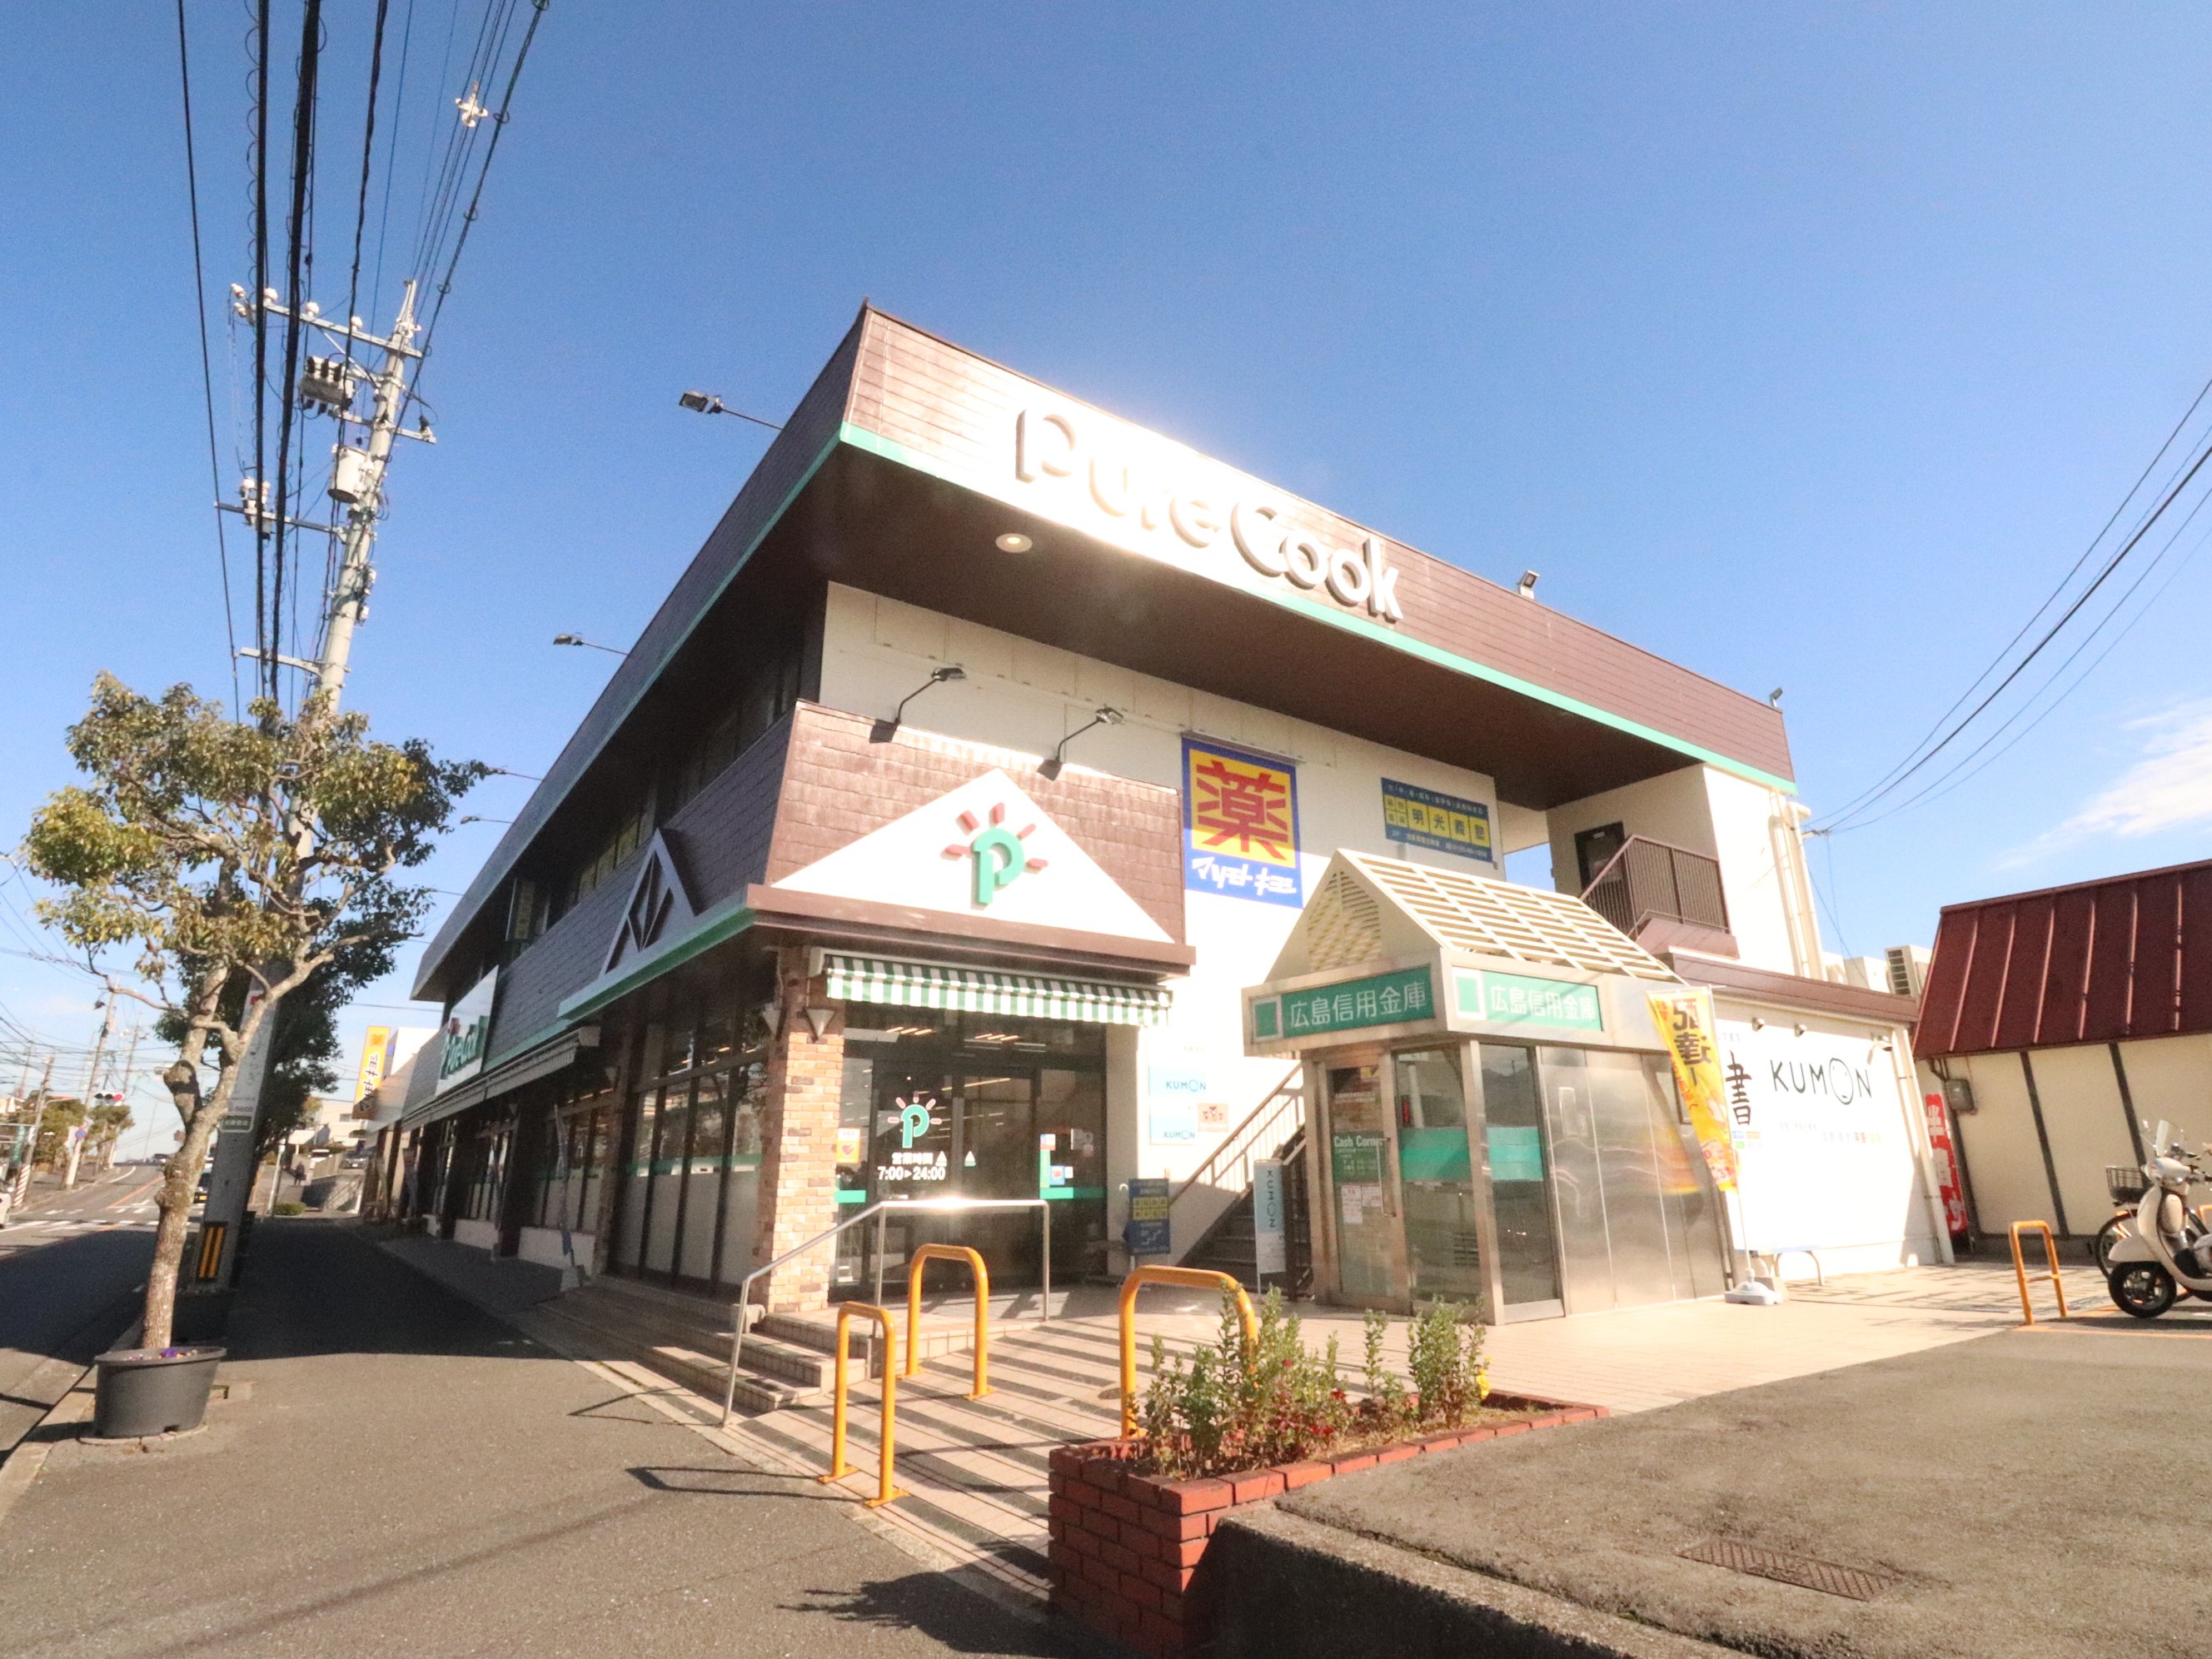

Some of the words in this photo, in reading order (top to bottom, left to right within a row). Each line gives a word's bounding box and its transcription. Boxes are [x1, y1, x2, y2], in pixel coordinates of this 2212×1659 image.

[1196, 759, 1288, 860] 薬
[1192, 855, 1297, 896] マツモトキヨシ
[1290, 981, 1427, 1029] 広島信用金庫
[1489, 984, 1597, 1022] 広島信用金庫
[1165, 1079, 1207, 1092] KUMON
[1770, 1057, 1872, 1105] KUMON
[1163, 1129, 1196, 1140] KUMON
[1333, 1135, 1354, 1148] Cash
[1265, 1169, 1278, 1228] KUMON
